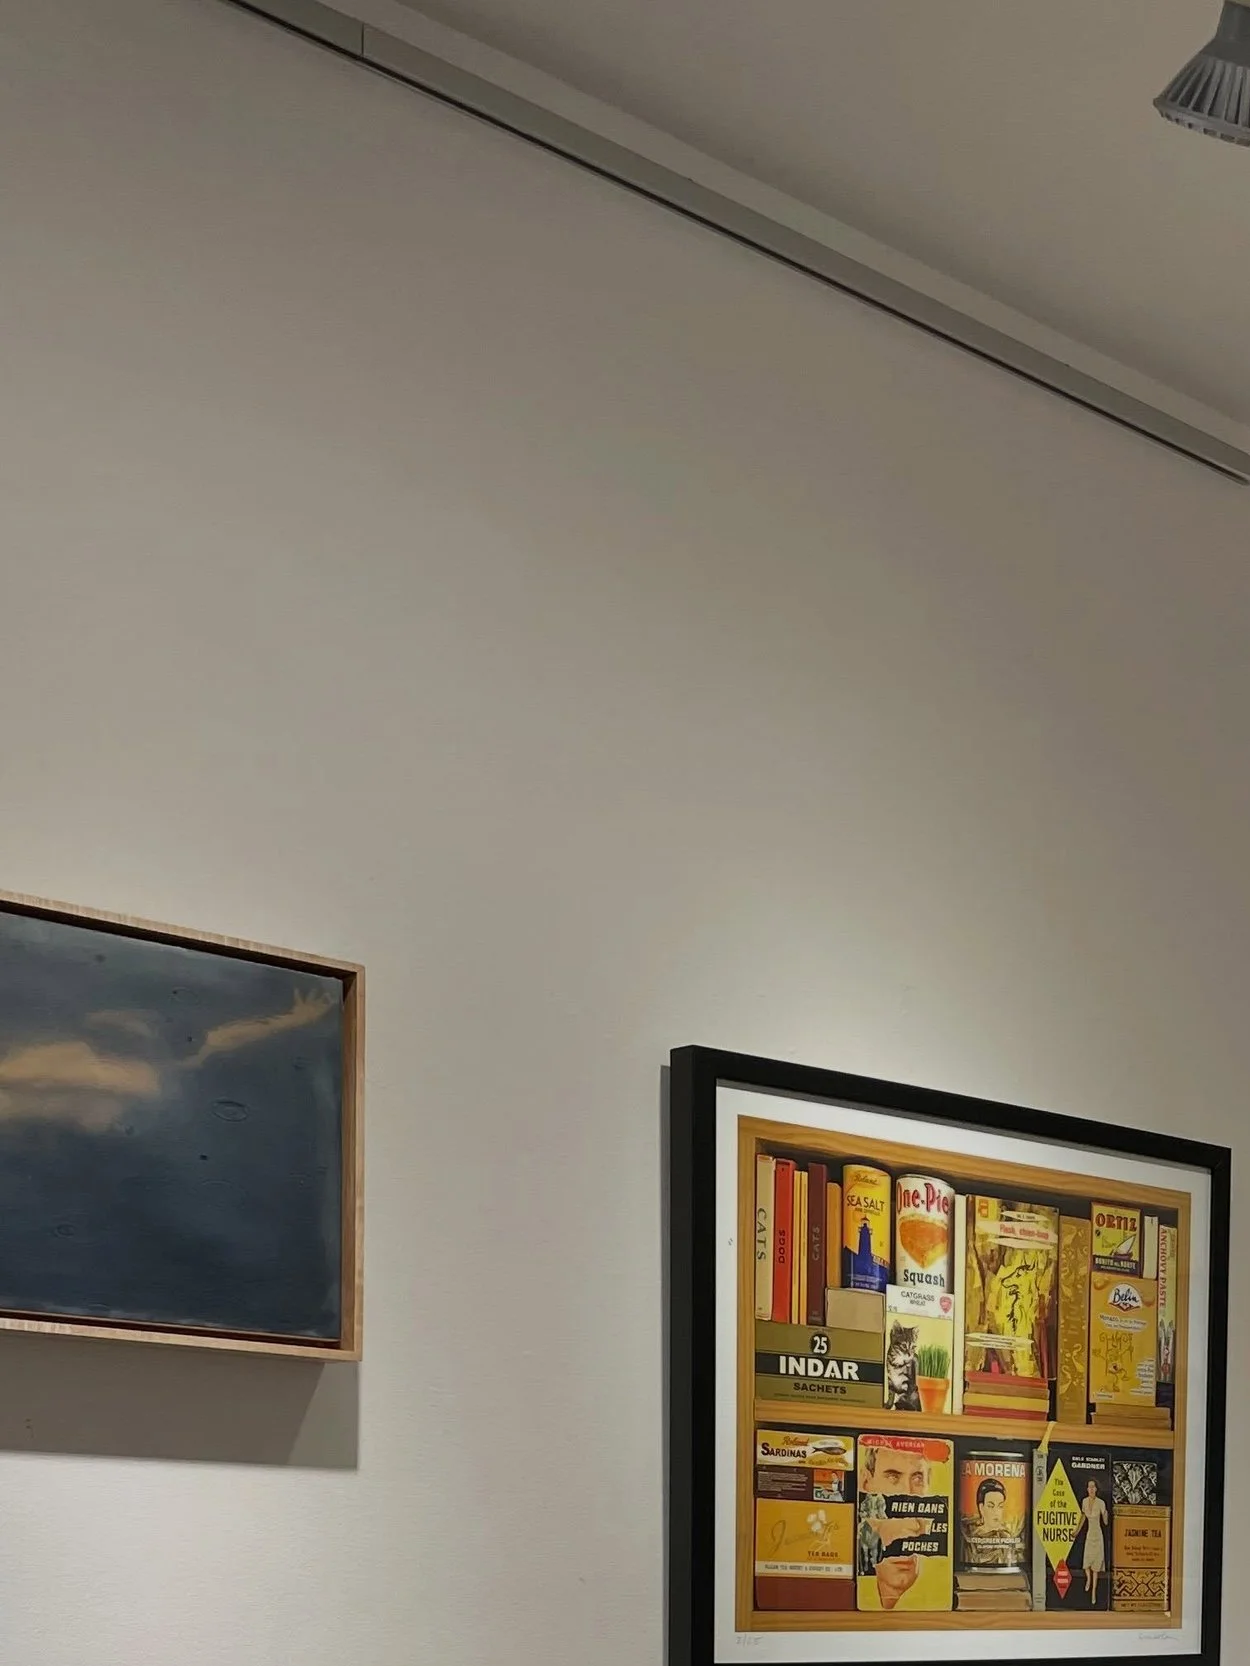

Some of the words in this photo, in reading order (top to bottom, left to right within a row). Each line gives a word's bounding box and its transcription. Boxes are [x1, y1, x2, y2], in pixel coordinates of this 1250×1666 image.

[847, 1195, 861, 1206] SEA
[864, 1197, 885, 1212] SALT
[1095, 1213, 1137, 1232] ORTIZ
[757, 1207, 767, 1260] CATS
[778, 1229, 786, 1264] DOGS
[811, 1226, 820, 1261] CATS
[1160, 1228, 1168, 1274] ANCHOVY
[904, 1269, 945, 1287] Squash
[901, 1290, 935, 1302] CATGRASS
[1158, 1276, 1167, 1307] PASTE
[813, 1336, 828, 1354] 25
[780, 1355, 859, 1380] INDAR
[793, 1382, 847, 1394] SACHETS
[761, 1443, 807, 1459] SARDINAS
[975, 1463, 1026, 1478] MORENA
[891, 1501, 914, 1513] RIEN
[917, 1502, 945, 1514] DANS
[1050, 1500, 1057, 1508] of
[1057, 1500, 1067, 1508] the
[1037, 1511, 1077, 1526] FUGITIVE
[932, 1523, 948, 1533] LES
[1042, 1528, 1074, 1542] NURSE
[1151, 1529, 1162, 1538] TEA
[902, 1541, 938, 1552] POCHES
